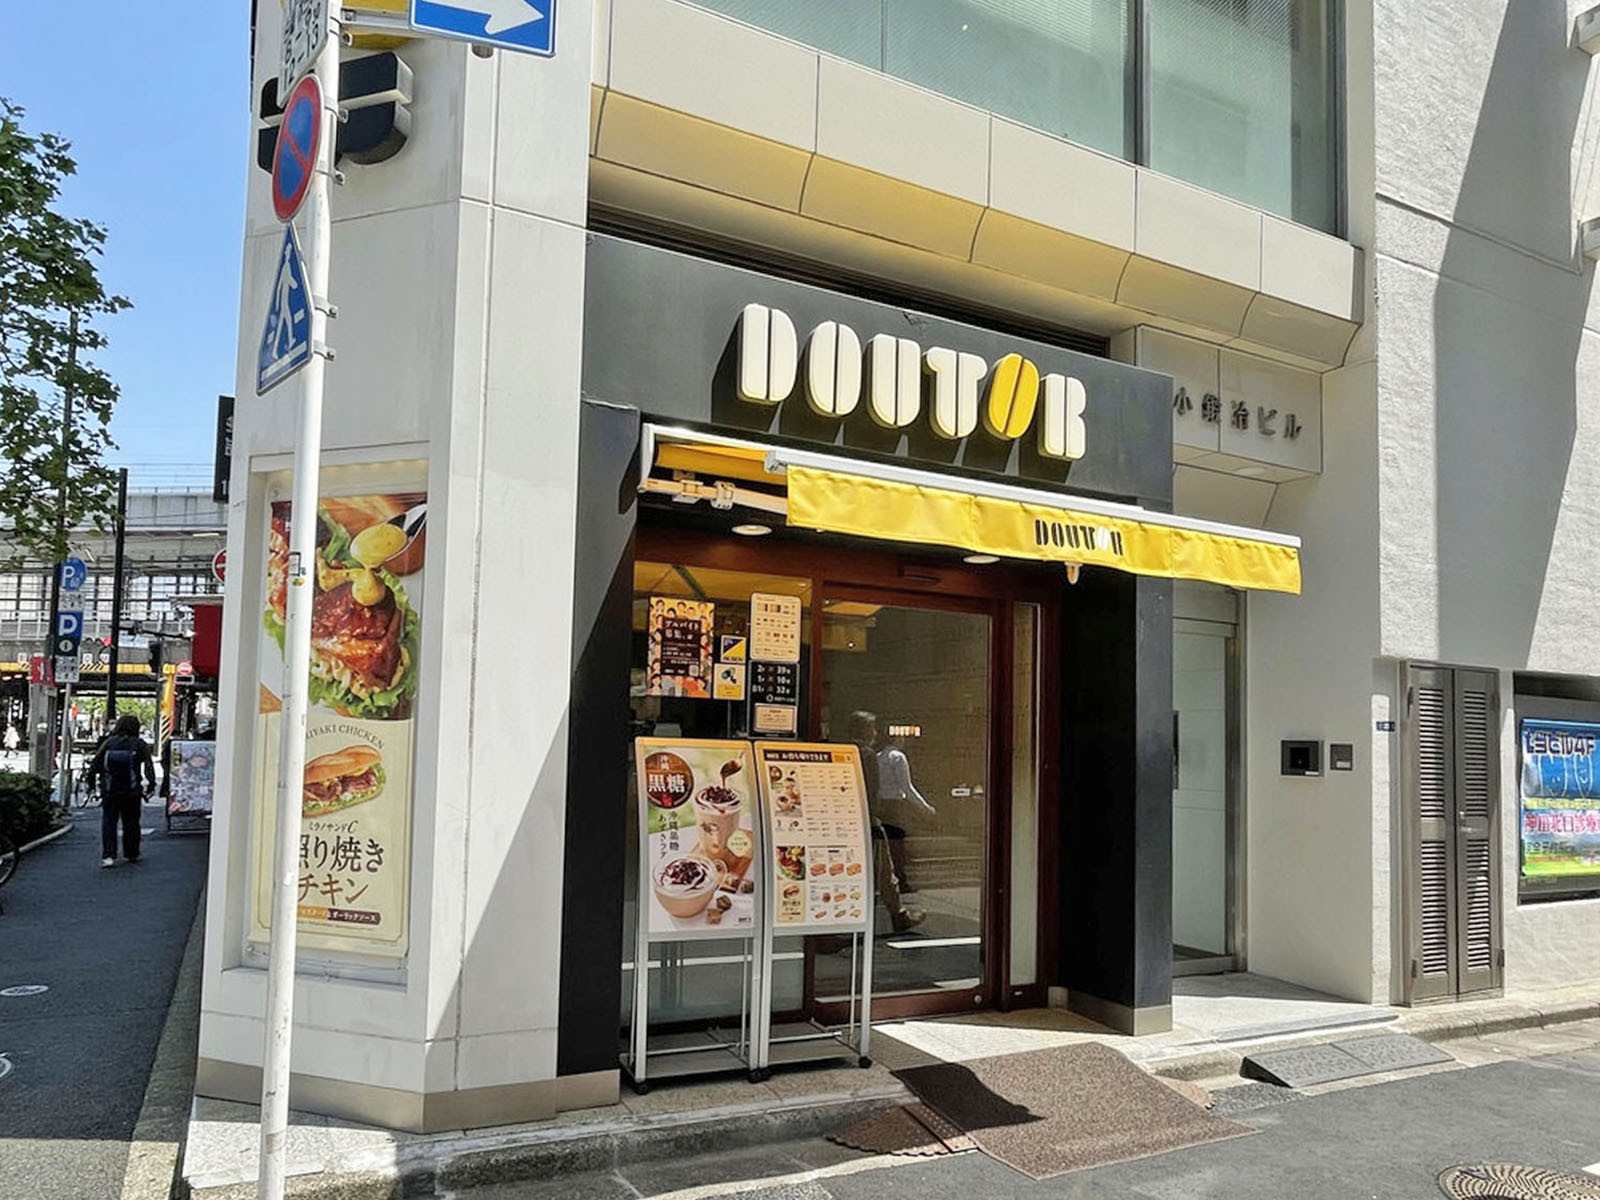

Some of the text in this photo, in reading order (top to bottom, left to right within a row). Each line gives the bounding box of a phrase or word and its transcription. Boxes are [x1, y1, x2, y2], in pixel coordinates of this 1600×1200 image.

[737, 303, 1087, 460] DOUTOR
[1035, 519, 1124, 557] DOUTOR
[58, 615, 78, 636] P
[339, 724, 385, 749] CHICKEN
[648, 773, 685, 793] 黒糖
[298, 873, 369, 906] チキン
